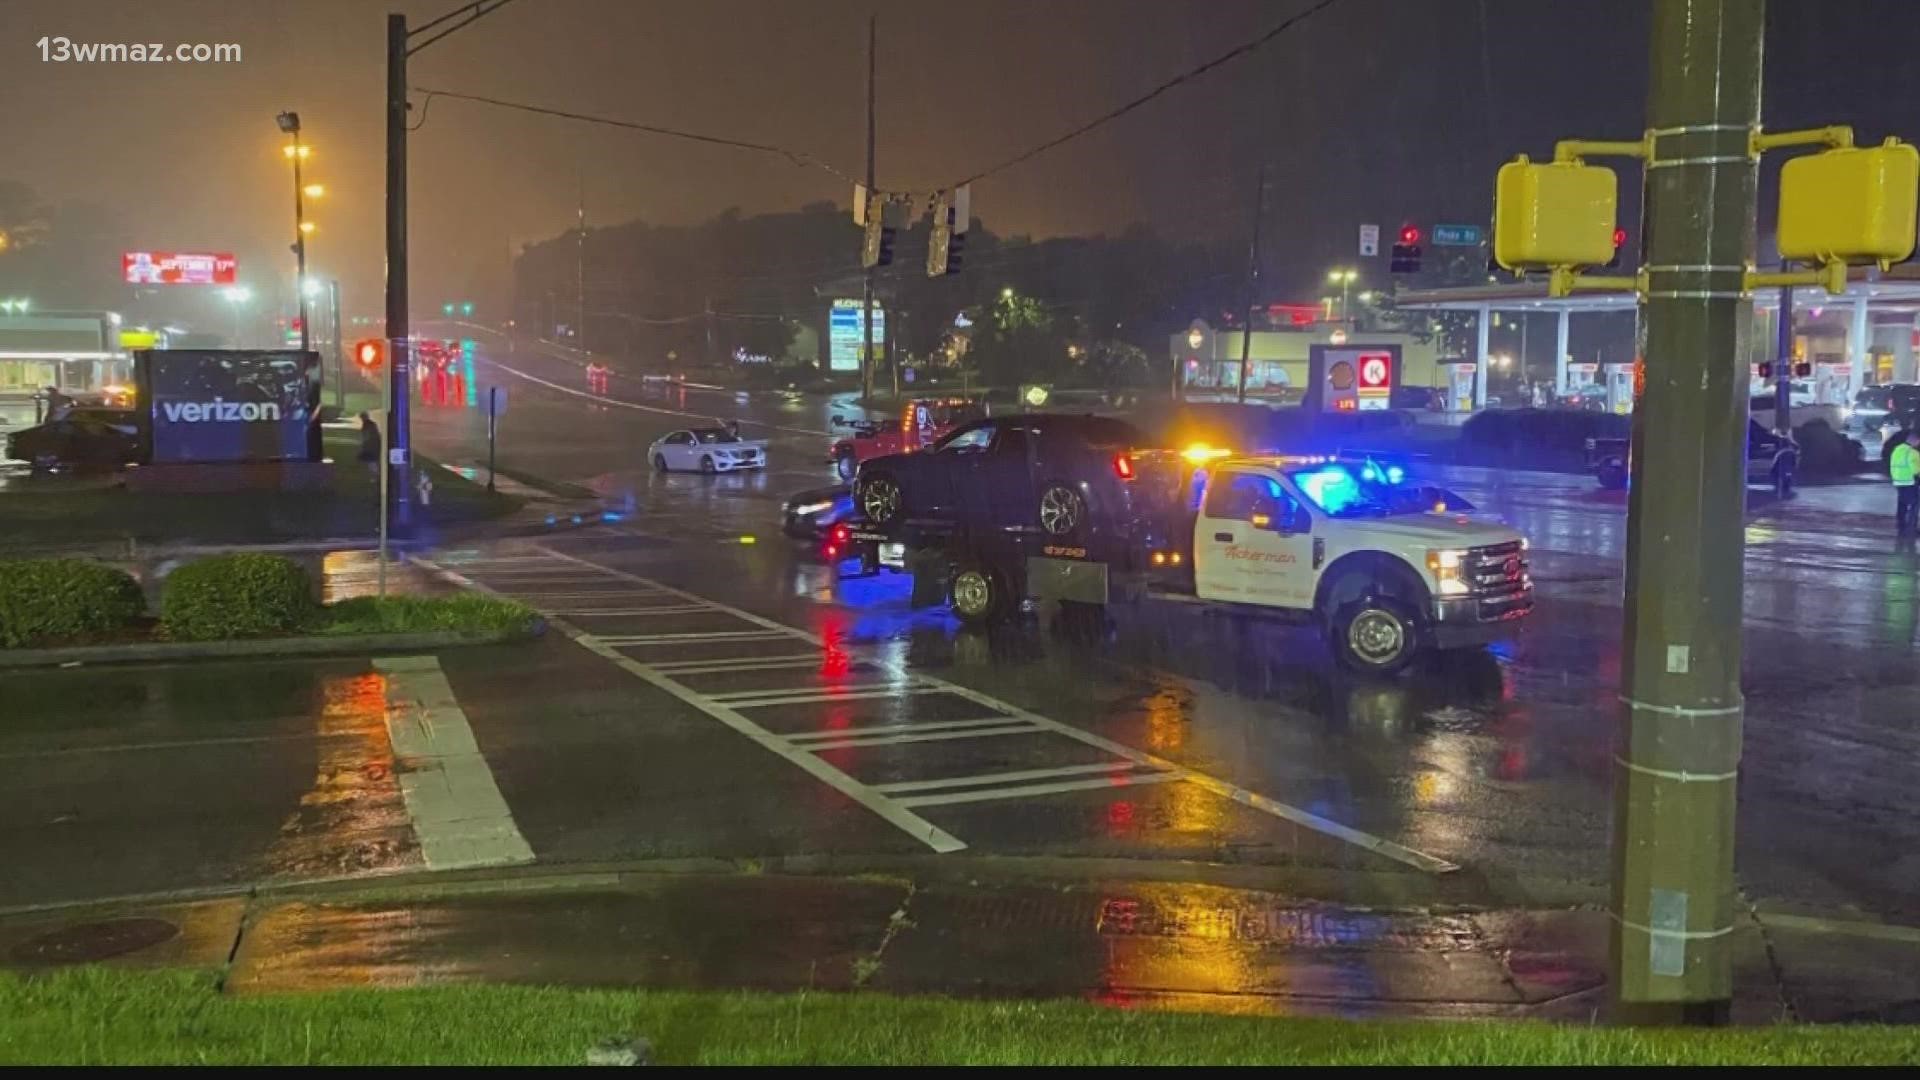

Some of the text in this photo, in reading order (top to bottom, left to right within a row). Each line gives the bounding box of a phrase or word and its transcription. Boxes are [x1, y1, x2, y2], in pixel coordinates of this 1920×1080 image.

[160, 259, 213, 272] SEPTEMBER
[1370, 365, 1381, 379] K
[163, 397, 280, 422] verizon
